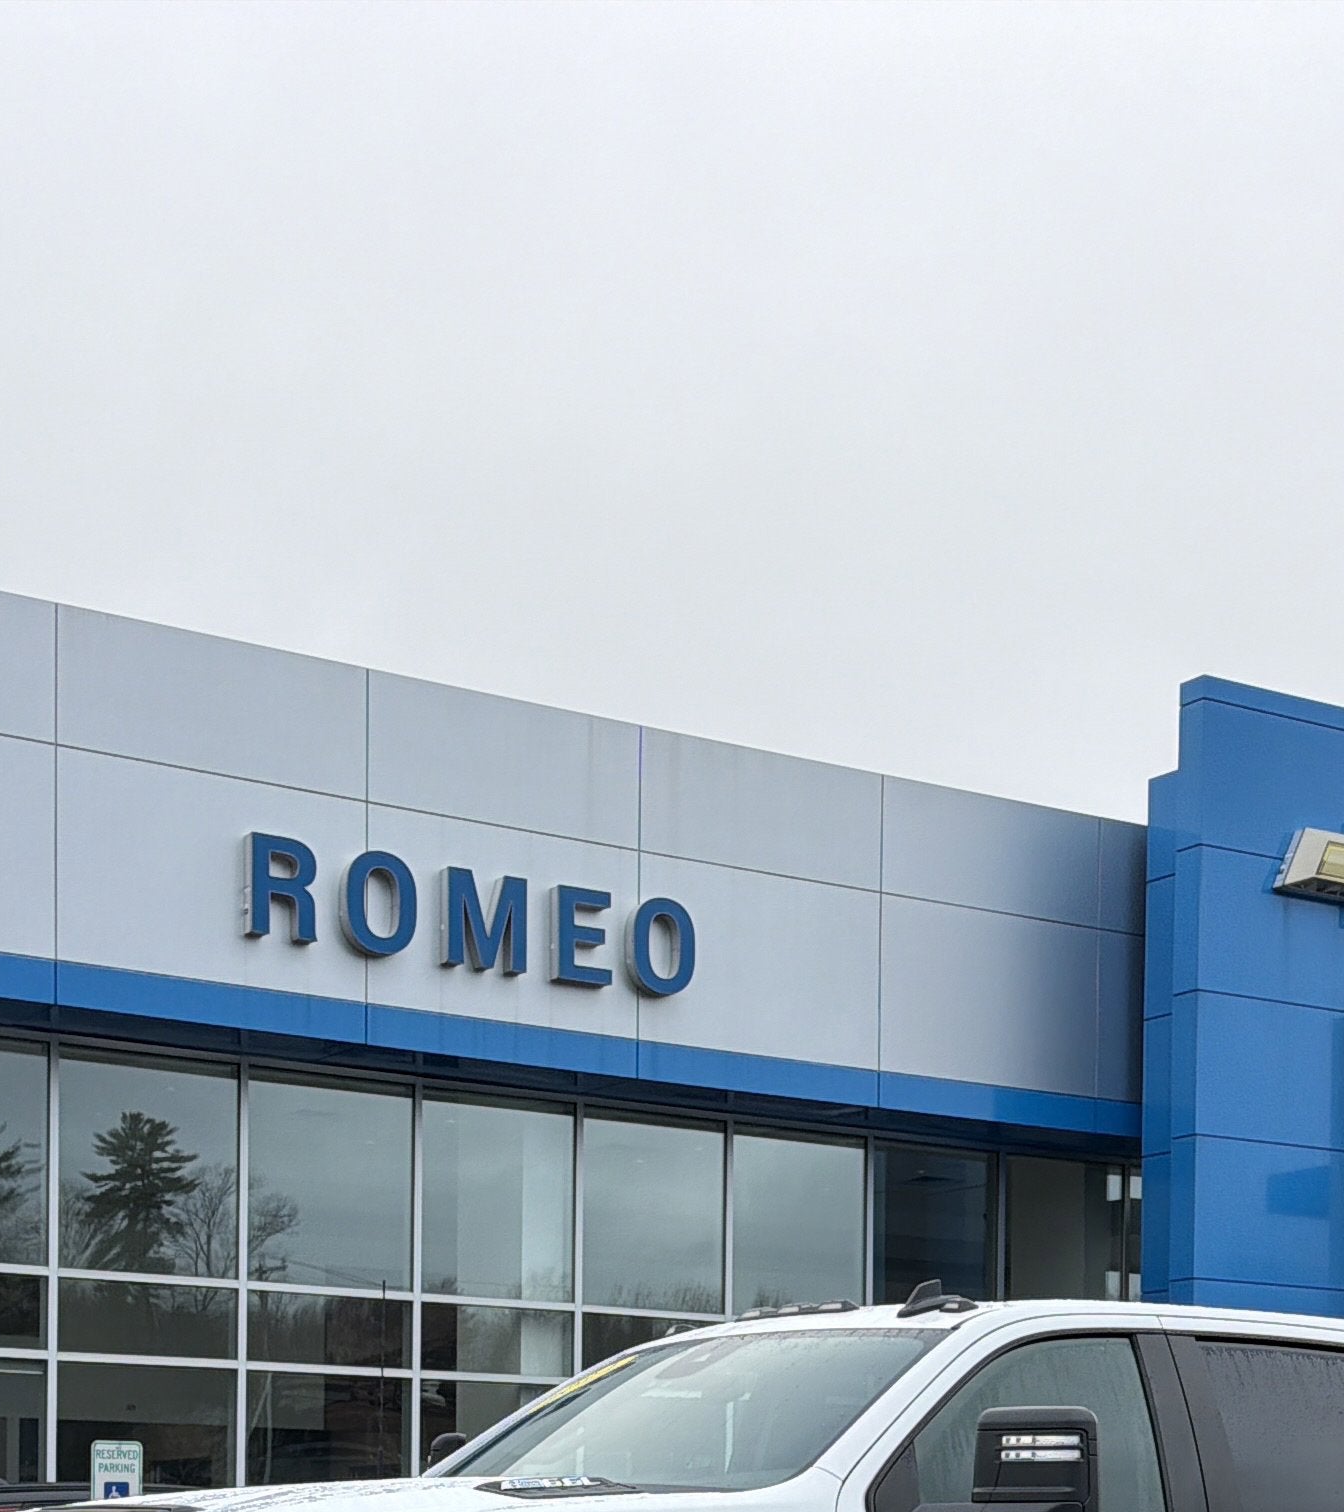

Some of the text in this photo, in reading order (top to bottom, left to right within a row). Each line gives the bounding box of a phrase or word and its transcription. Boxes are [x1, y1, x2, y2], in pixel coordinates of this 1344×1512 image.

[243, 831, 696, 998] ROMEO
[96, 1449, 139, 1460] RESERVED
[98, 1463, 136, 1473] PARKING
